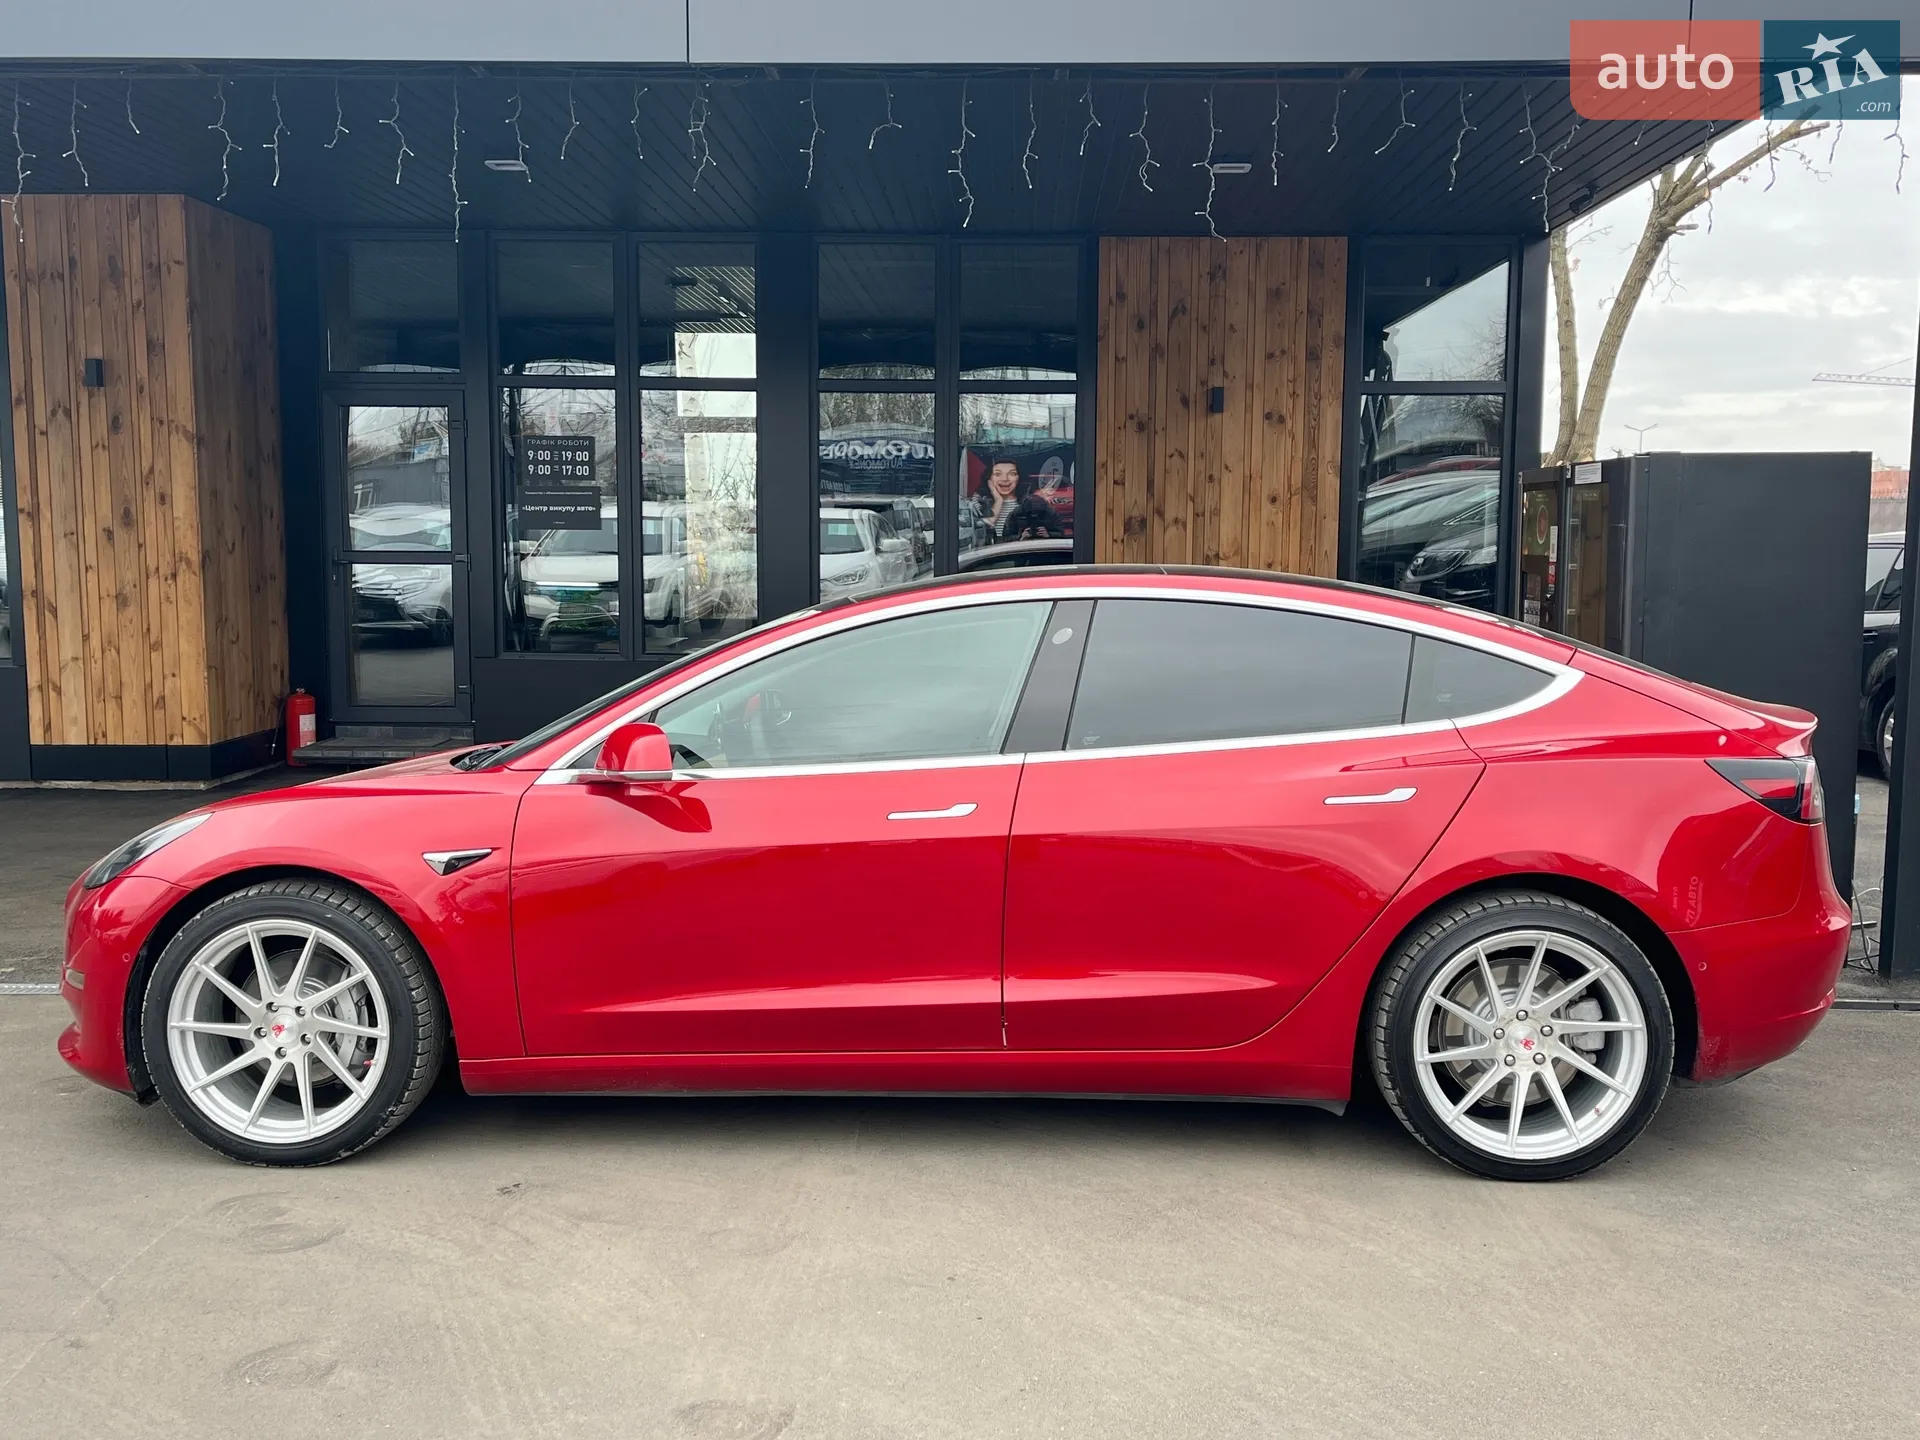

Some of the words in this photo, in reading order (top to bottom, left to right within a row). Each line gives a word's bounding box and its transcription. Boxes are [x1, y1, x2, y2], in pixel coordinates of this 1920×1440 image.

[528, 450, 550, 460] 9:00
[562, 451, 589, 462] 19:00
[528, 464, 551, 474] 9:00
[562, 466, 590, 476] 17:00
